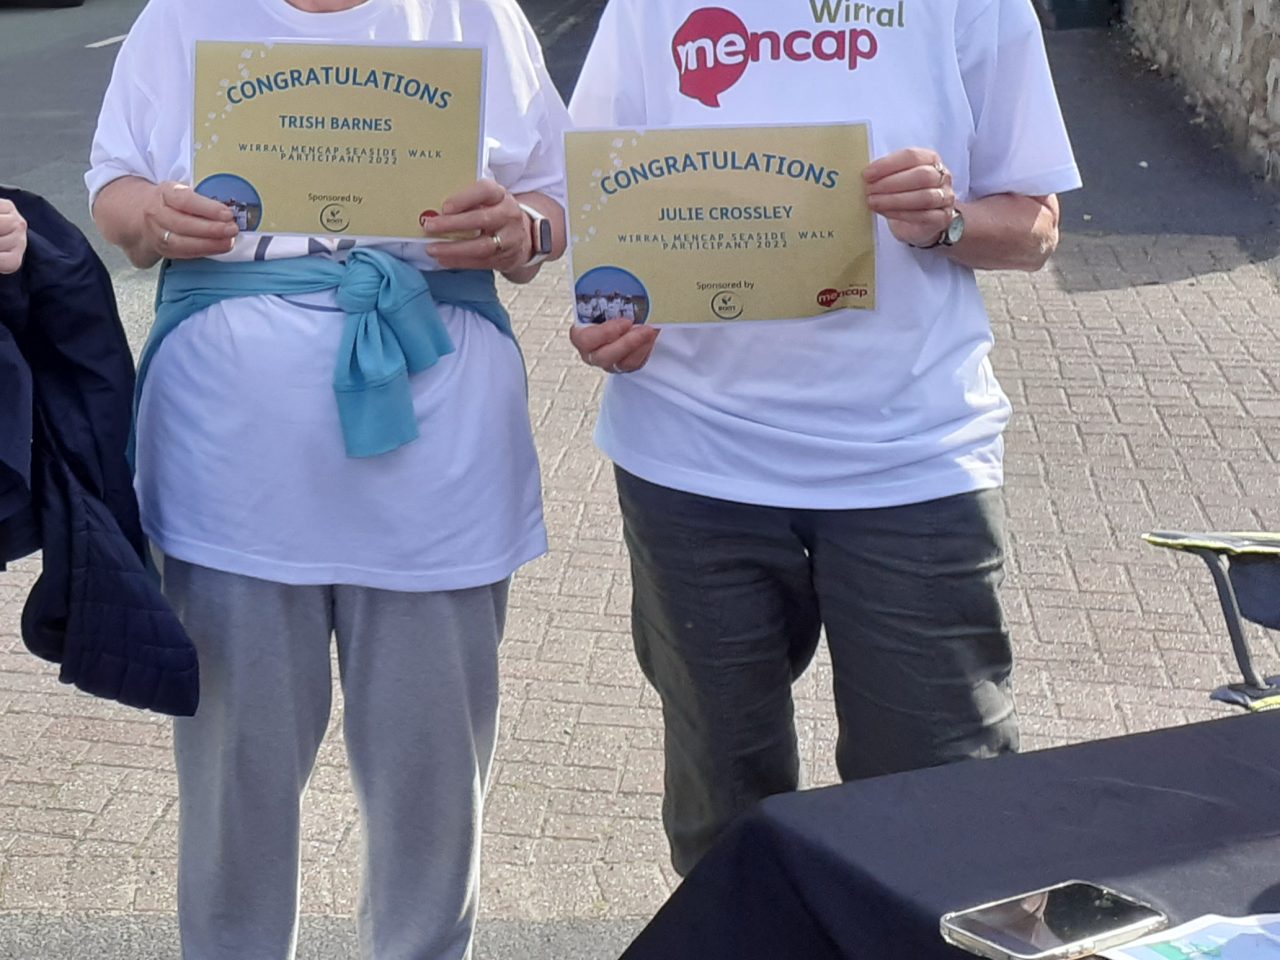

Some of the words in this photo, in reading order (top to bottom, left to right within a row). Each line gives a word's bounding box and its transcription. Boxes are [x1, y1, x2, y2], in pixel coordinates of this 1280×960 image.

[677, 28, 878, 75] mencap
[227, 66, 453, 109] CONGRATULATIONS
[279, 115, 325, 129] TRISH
[330, 117, 392, 132] BARNES
[239, 143, 285, 153] WIRRAL
[292, 145, 339, 155] MENCAP
[346, 147, 397, 157] SEASIDE
[408, 149, 442, 158] WALK
[281, 152, 362, 163] PARTICIPANT
[369, 156, 398, 165] 2022
[600, 151, 839, 195] CONGRATULATIONS
[308, 192, 351, 202] Sponsored
[353, 194, 363, 204] by
[658, 207, 703, 221] JULIE
[709, 206, 793, 220] CROSSLEY
[618, 234, 665, 242] WIRRAL
[673, 233, 724, 241] MENCAP
[731, 232, 786, 240] SEASIDE
[798, 230, 835, 239] WALK
[663, 241, 750, 250] PARTICIPANT
[757, 240, 788, 248] 2022
[696, 281, 742, 290] Sponsored
[744, 280, 755, 290] by
